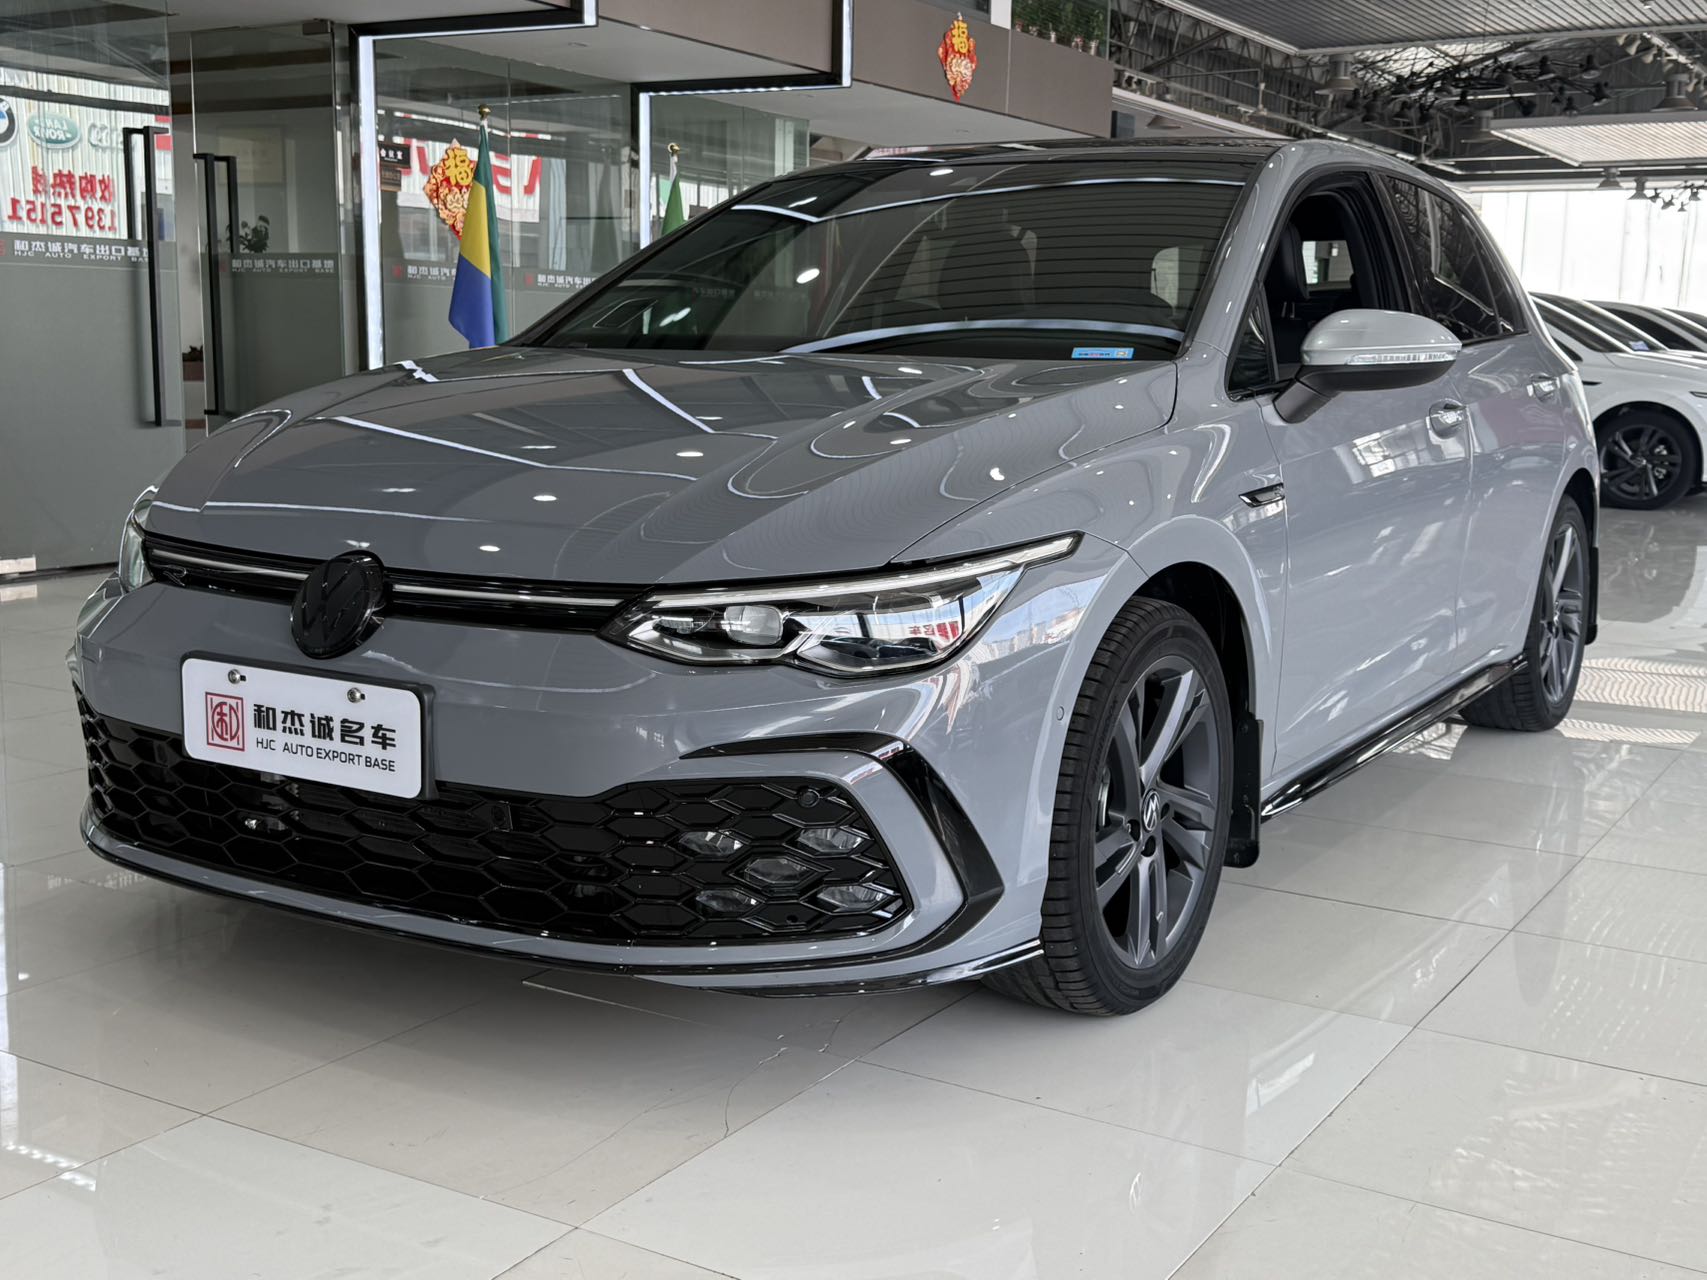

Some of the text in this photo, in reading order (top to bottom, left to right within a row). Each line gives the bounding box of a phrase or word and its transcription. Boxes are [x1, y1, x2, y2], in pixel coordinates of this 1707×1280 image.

[253, 703, 397, 750] 和杰诚名车
[256, 737, 396, 772] HJC AUTO EXPORT BASE
